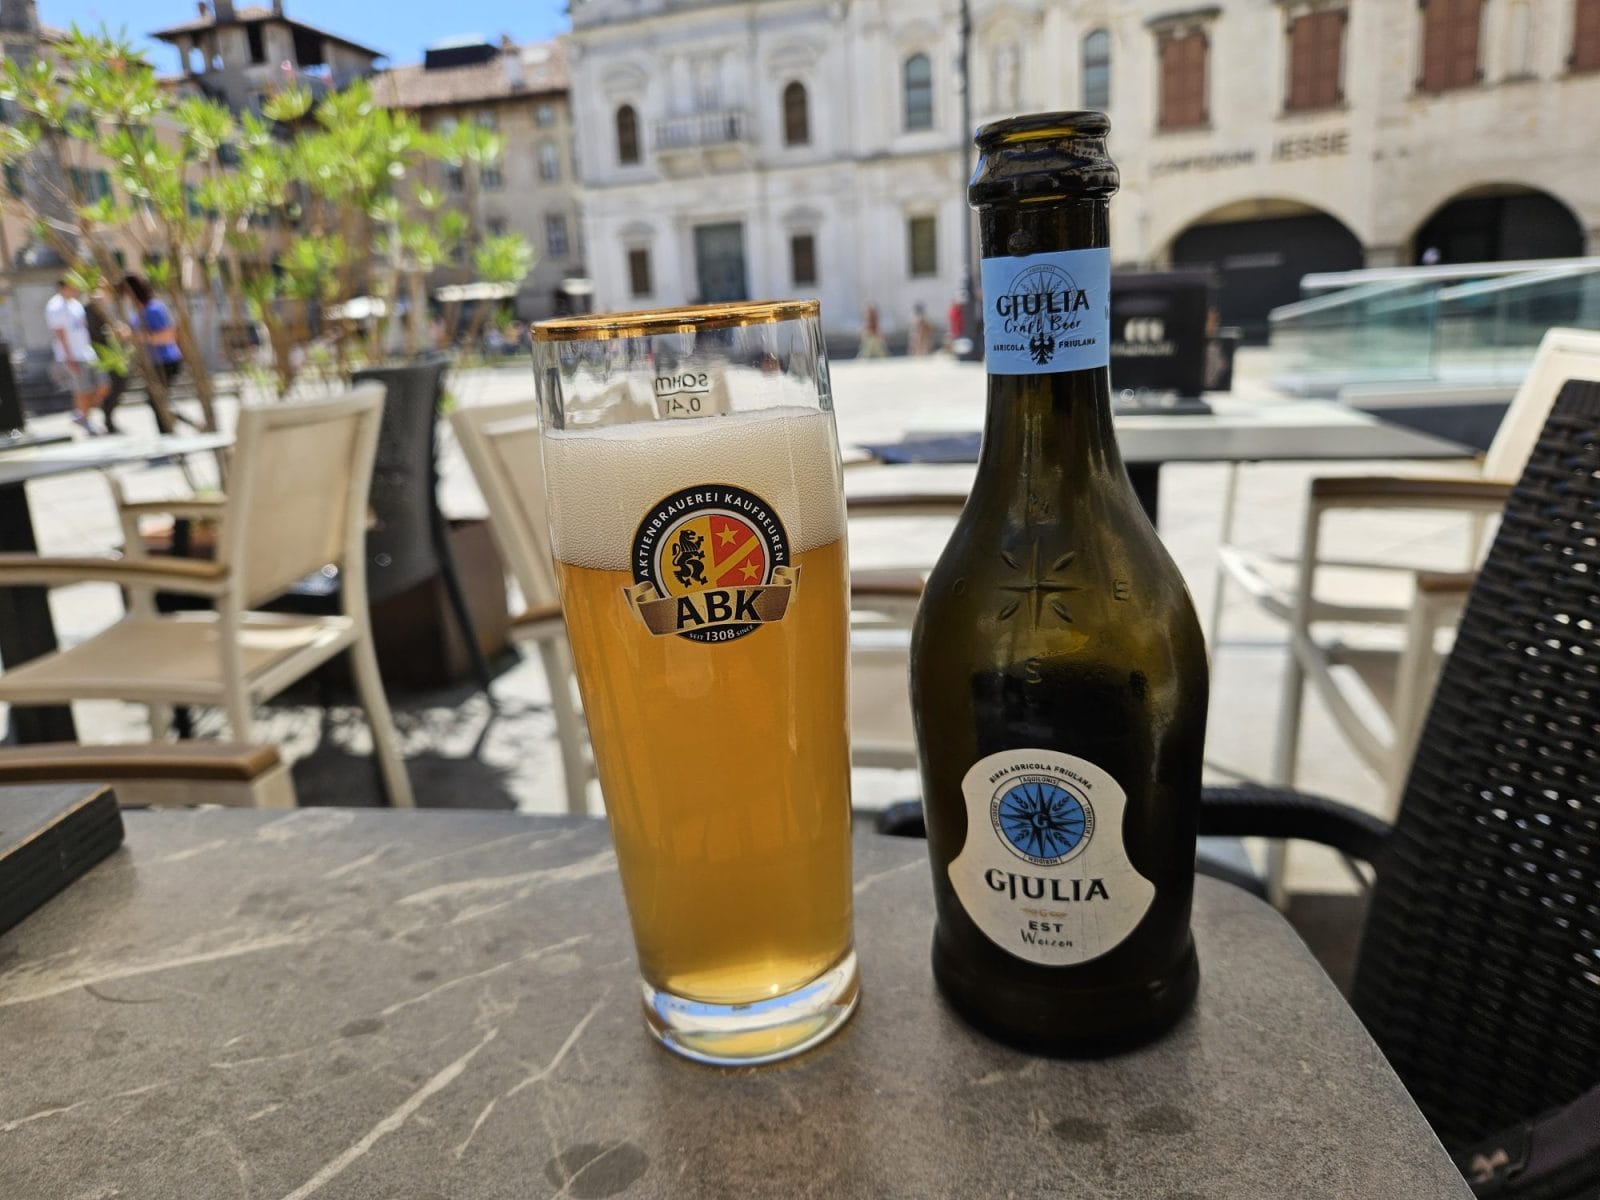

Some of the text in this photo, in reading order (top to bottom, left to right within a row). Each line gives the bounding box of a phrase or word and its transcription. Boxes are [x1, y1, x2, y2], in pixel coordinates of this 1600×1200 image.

[996, 289, 1090, 321] GIULIA
[1004, 315, 1082, 335] Craft Beer
[639, 492, 784, 577] AKTIENBRAUEREI KAUFBEUREN
[676, 589, 764, 630] ABK
[705, 629, 735, 641] 1308
[1010, 763, 1051, 773] AGRICOLA
[1054, 766, 1093, 790] FRIULANA
[984, 868, 1110, 901] GIULIA
[1020, 928, 1073, 948] Weizen
[1028, 920, 1063, 933] EST
